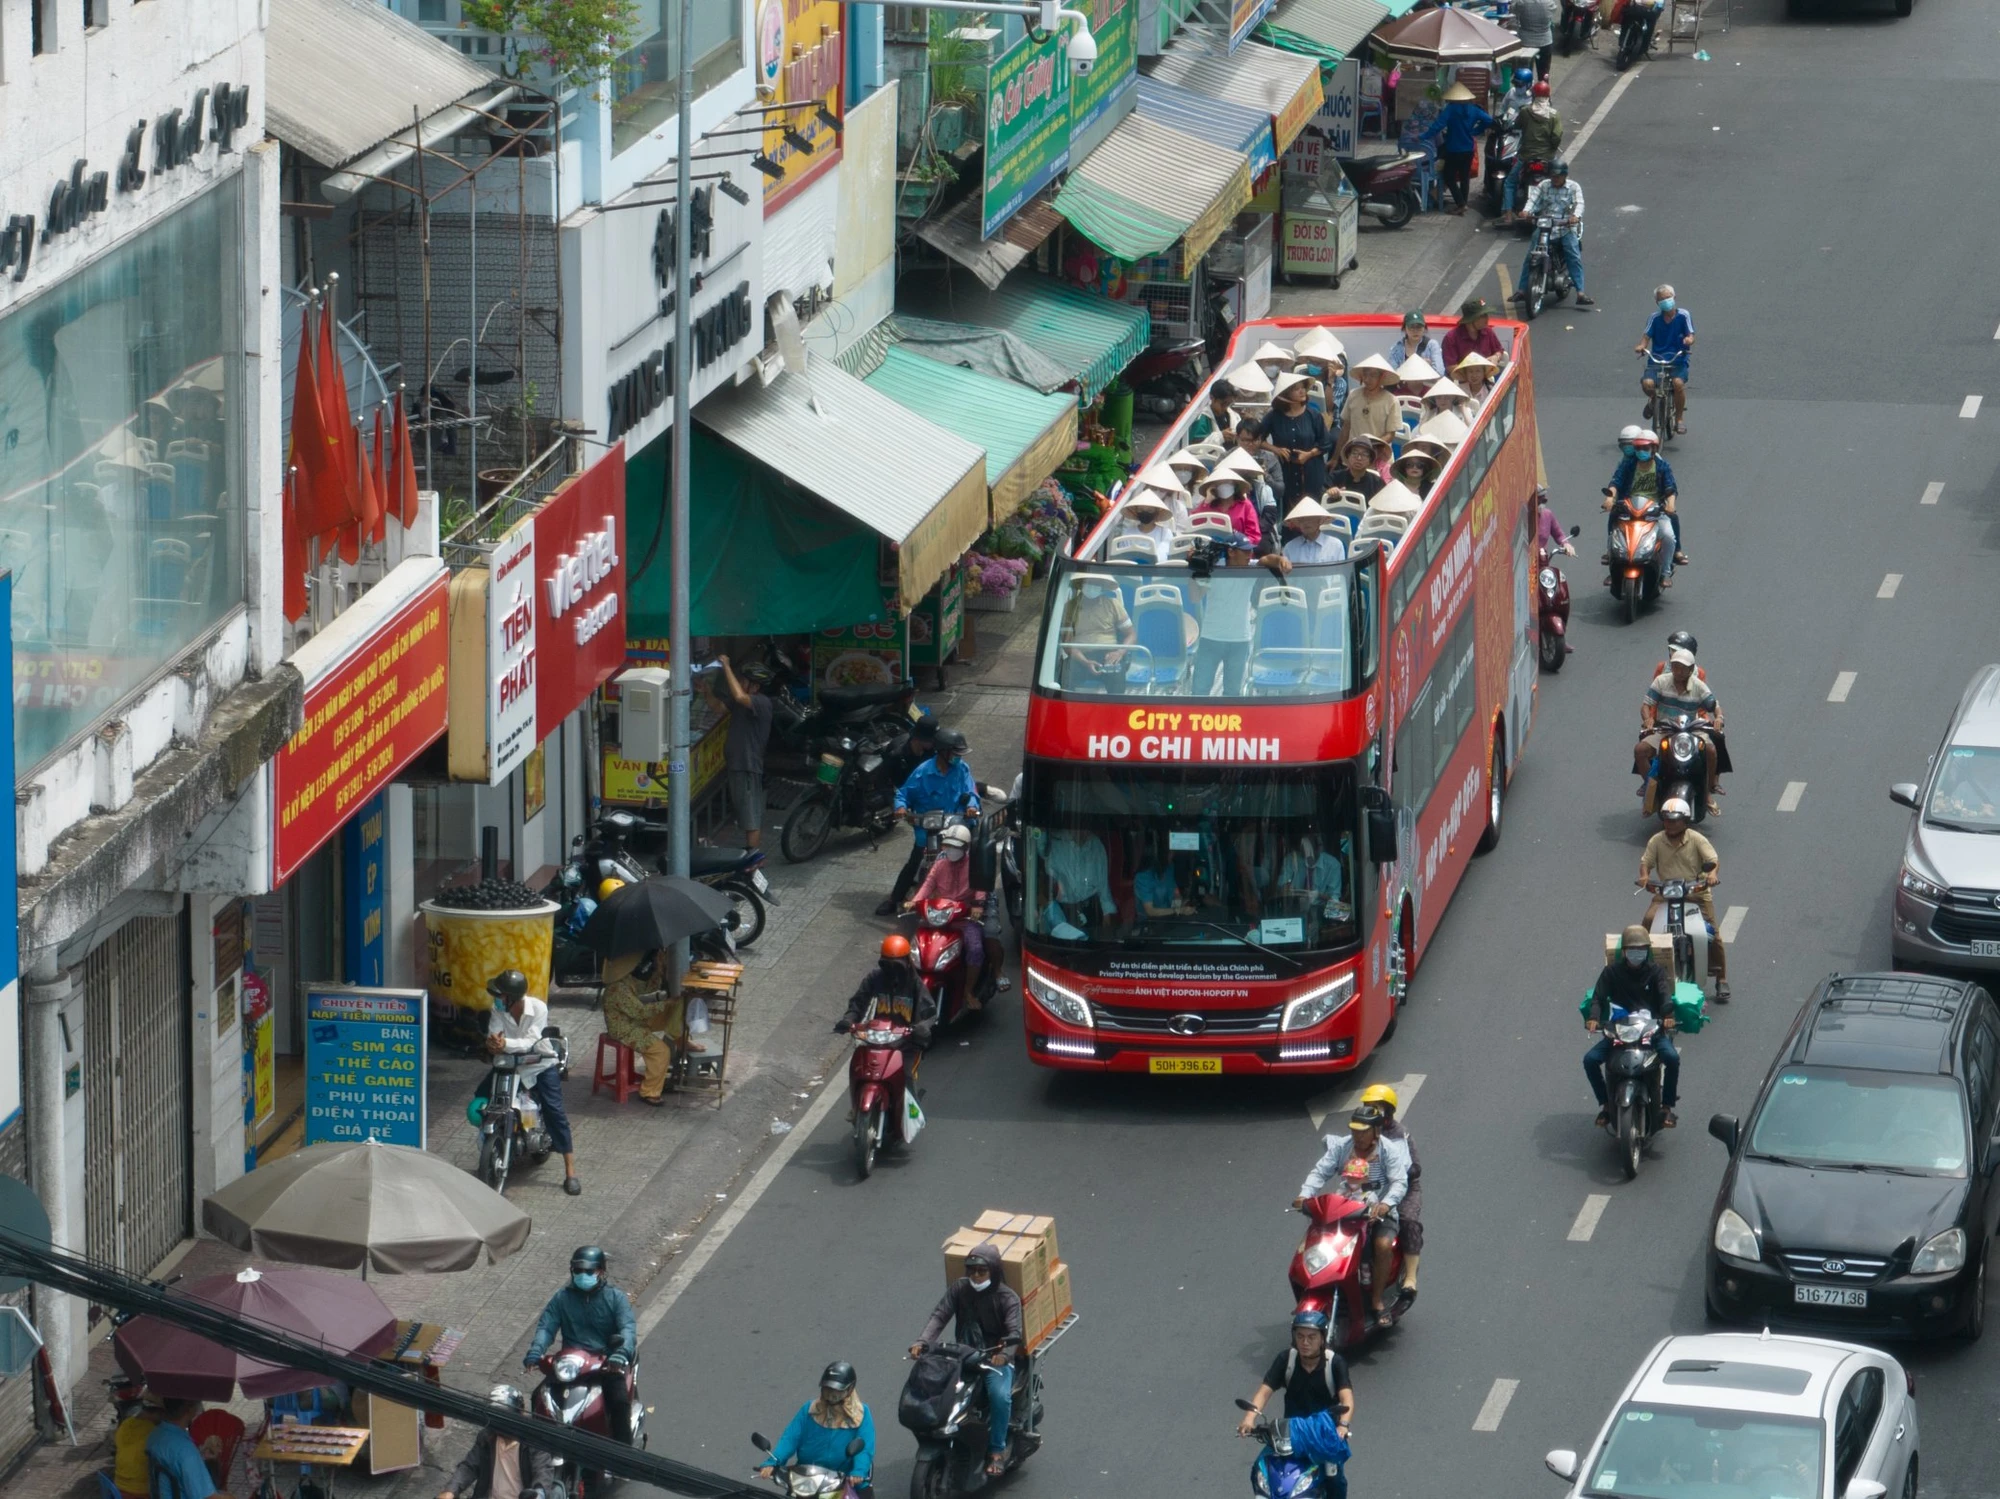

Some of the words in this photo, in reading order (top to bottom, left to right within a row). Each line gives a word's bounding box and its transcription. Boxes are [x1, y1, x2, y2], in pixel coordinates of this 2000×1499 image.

[1318, 85, 1352, 118] HUỐC
[1430, 573, 1442, 619] HO
[1128, 709, 1182, 731] CITY
[1188, 713, 1242, 732] TOUR
[1088, 735, 1131, 759] HO
[1139, 735, 1192, 760] CHI
[1201, 737, 1280, 761] MINH
[1110, 962, 1120, 970] Dự
[1121, 962, 1130, 970] án
[1141, 962, 1158, 970] điểm
[1159, 962, 1175, 972] phát
[1176, 962, 1191, 971] triển
[1192, 963, 1202, 971] du
[1203, 963, 1215, 972] lịch
[1216, 963, 1228, 971] của
[1229, 963, 1249, 972] Chính
[1250, 963, 1264, 973] phủ
[1099, 970, 1124, 979] Priority
[1124, 971, 1148, 980] Project
[1158, 971, 1184, 980] develop
[1185, 972, 1212, 980] tourism
[1212, 972, 1221, 981] by
[1222, 972, 1233, 980] the
[1234, 973, 1277, 981] Government
[1171, 988, 1235, 998] HOPON-HOPOFF
[312, 1010, 337, 1021] NẠP
[375, 1012, 415, 1023] MOMO
[352, 1041, 385, 1053] SIM
[392, 1043, 415, 1054] 4G
[336, 1055, 372, 1069] THẺ
[1156, 1060, 1216, 1071] 50H-396.62
[322, 1071, 357, 1085] THẺ
[364, 1075, 415, 1088] GAME
[329, 1091, 365, 1103] PHỤ
[372, 1092, 415, 1106] KIỆN
[312, 1105, 354, 1120] ĐIỆN
[361, 1109, 415, 1124] THOẠI
[333, 1122, 363, 1136] GIÁ
[369, 1123, 393, 1138] RẺ
